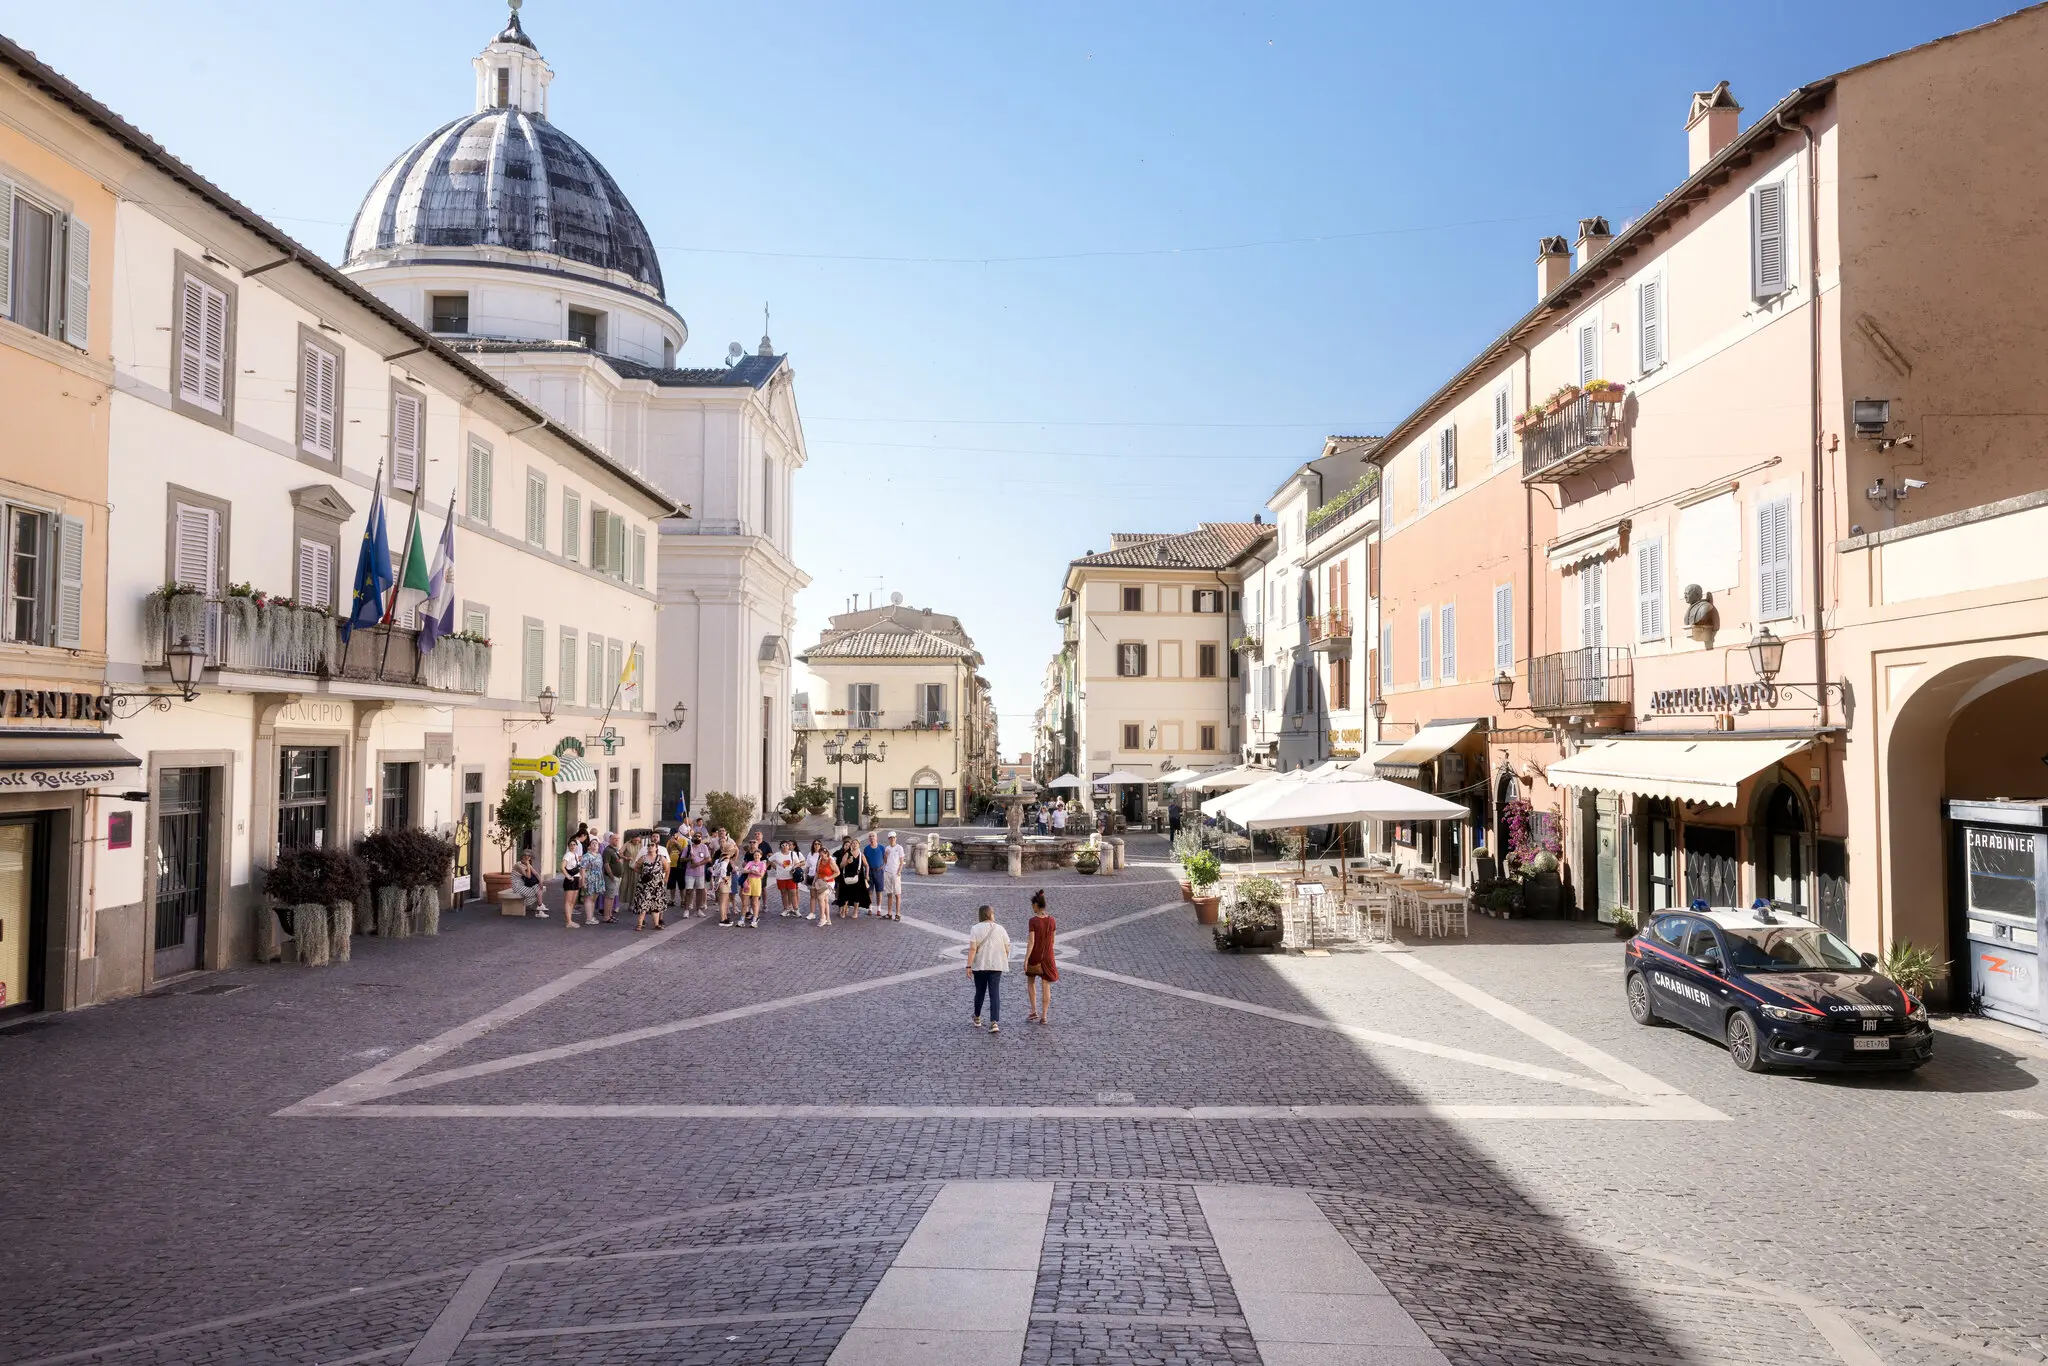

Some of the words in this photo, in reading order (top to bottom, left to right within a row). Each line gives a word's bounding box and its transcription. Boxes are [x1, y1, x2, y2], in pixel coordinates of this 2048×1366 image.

[1650, 682, 1771, 709] ARTIGIANATO
[281, 703, 343, 722] MUNICIPIO
[540, 761, 557, 771] PT
[0, 772, 28, 785] oli
[30, 768, 115, 788] Religiosi
[1969, 832, 2034, 853] CARABINIER
[1654, 971, 1711, 1007] CARABINIERI
[1829, 1004, 1895, 1012] CARABINIERI
[1862, 1020, 1878, 1031] FIAT
